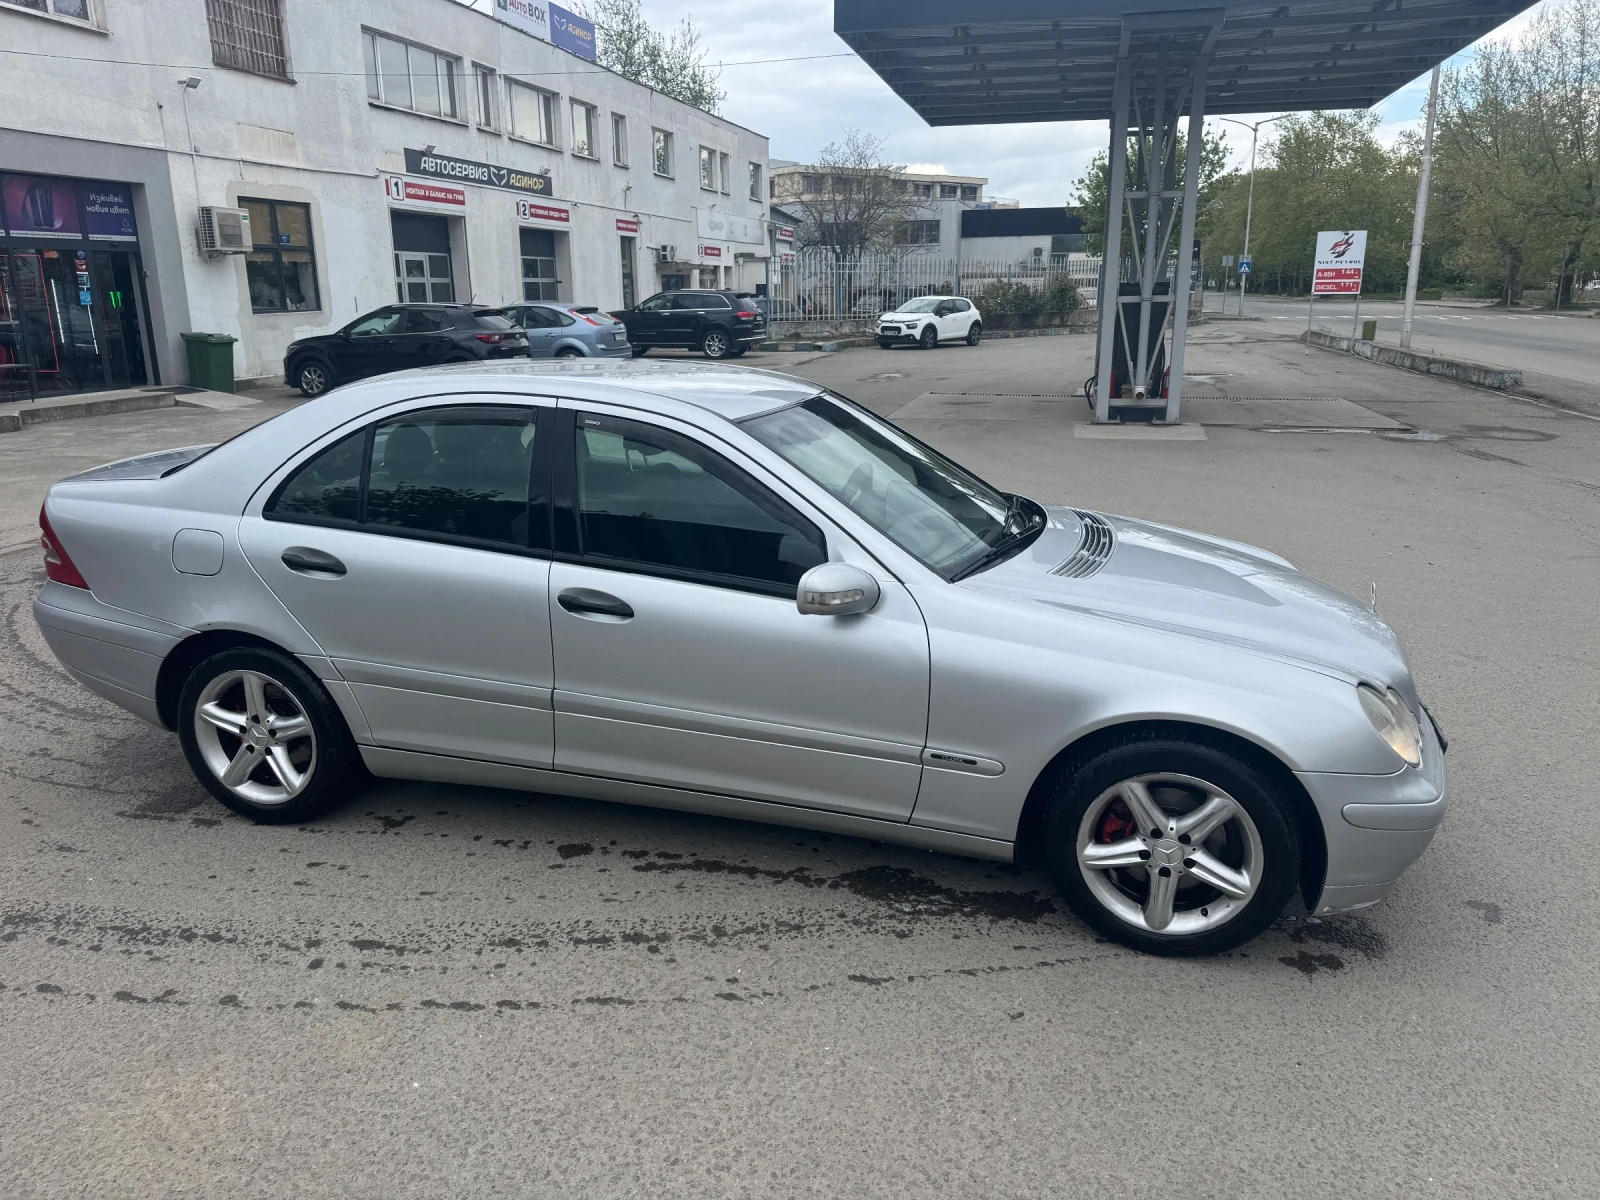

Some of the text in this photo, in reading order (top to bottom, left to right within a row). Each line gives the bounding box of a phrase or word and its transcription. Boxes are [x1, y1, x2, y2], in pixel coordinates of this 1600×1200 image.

[420, 157, 544, 190] АВТОСЕРВИЗ АДИНОР
[394, 181, 400, 197] 1
[405, 186, 425, 197] МОНТАЖ
[429, 190, 447, 199] БАЛАНС
[89, 192, 123, 204] Изживей
[86, 204, 130, 215] новия цвят
[521, 203, 527, 217] 2
